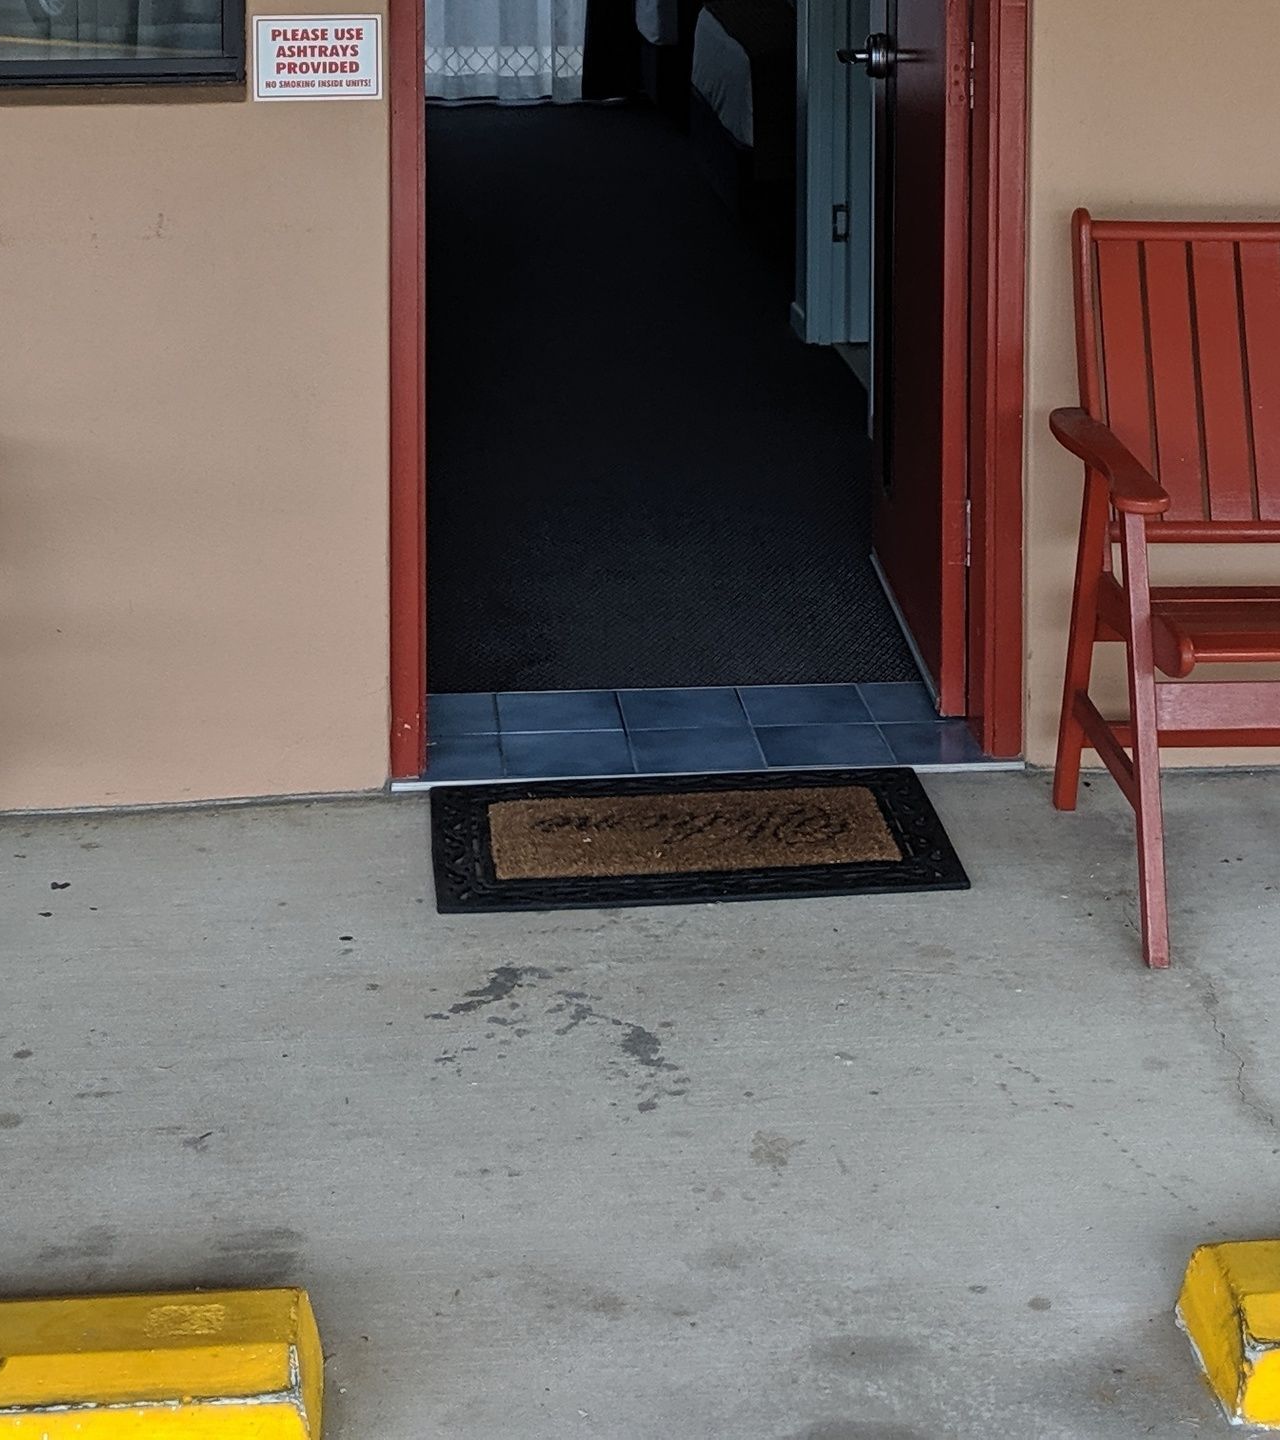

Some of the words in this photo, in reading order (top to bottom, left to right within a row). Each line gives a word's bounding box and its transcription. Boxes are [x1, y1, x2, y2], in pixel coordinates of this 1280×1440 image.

[271, 28, 329, 42] PLEASE
[334, 27, 364, 41] USE
[276, 44, 360, 58] ASHTRAYS
[275, 61, 360, 75] PROVIDED
[265, 80, 277, 89] NO
[278, 79, 316, 89] SMOKING
[318, 79, 344, 88] INSIDE
[345, 78, 371, 88] UNITS!
